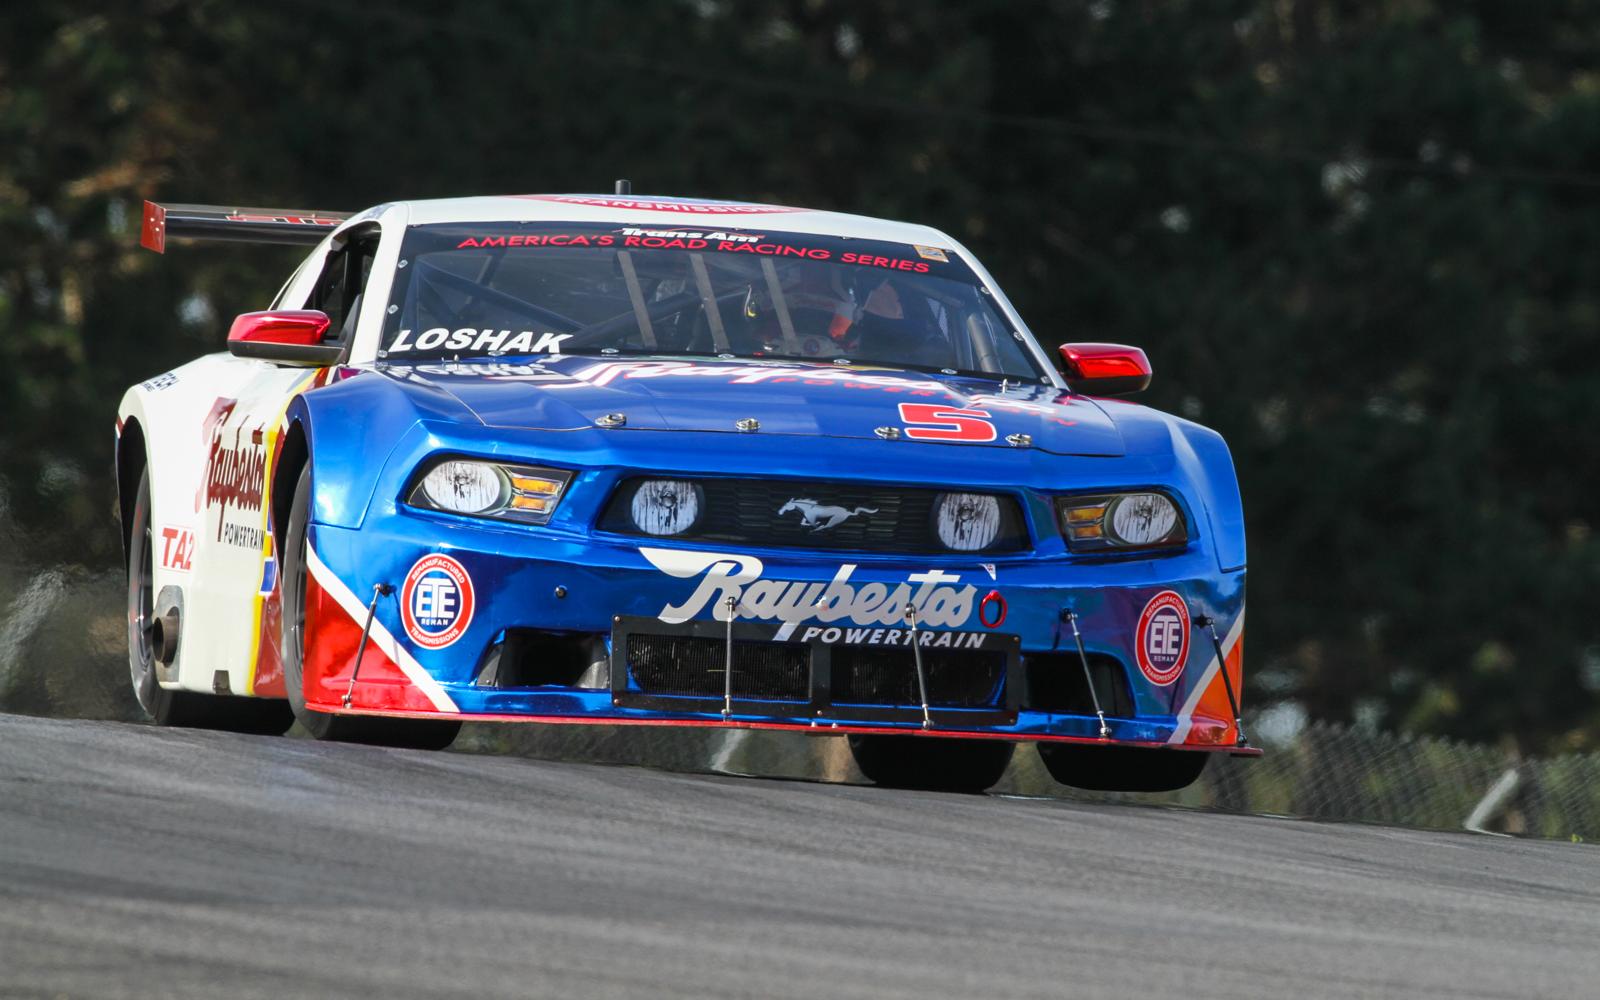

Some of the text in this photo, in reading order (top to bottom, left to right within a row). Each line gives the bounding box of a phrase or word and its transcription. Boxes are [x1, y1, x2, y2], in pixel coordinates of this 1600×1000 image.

[621, 227, 759, 243] Trans Am
[457, 234, 930, 273] AMERICA'S ROAD RACING SERIES
[389, 327, 573, 354] LOSHAK
[898, 402, 998, 442] 5
[162, 527, 193, 571] TA2
[411, 557, 466, 584] REMANUFACTURED
[415, 577, 456, 619] ETE
[638, 546, 978, 642] Raybestos
[410, 625, 459, 645] TRANSMISSIONS
[420, 618, 449, 626] REMAN
[800, 625, 987, 649] POWERTRAIN
[1149, 615, 1180, 655] ETE
